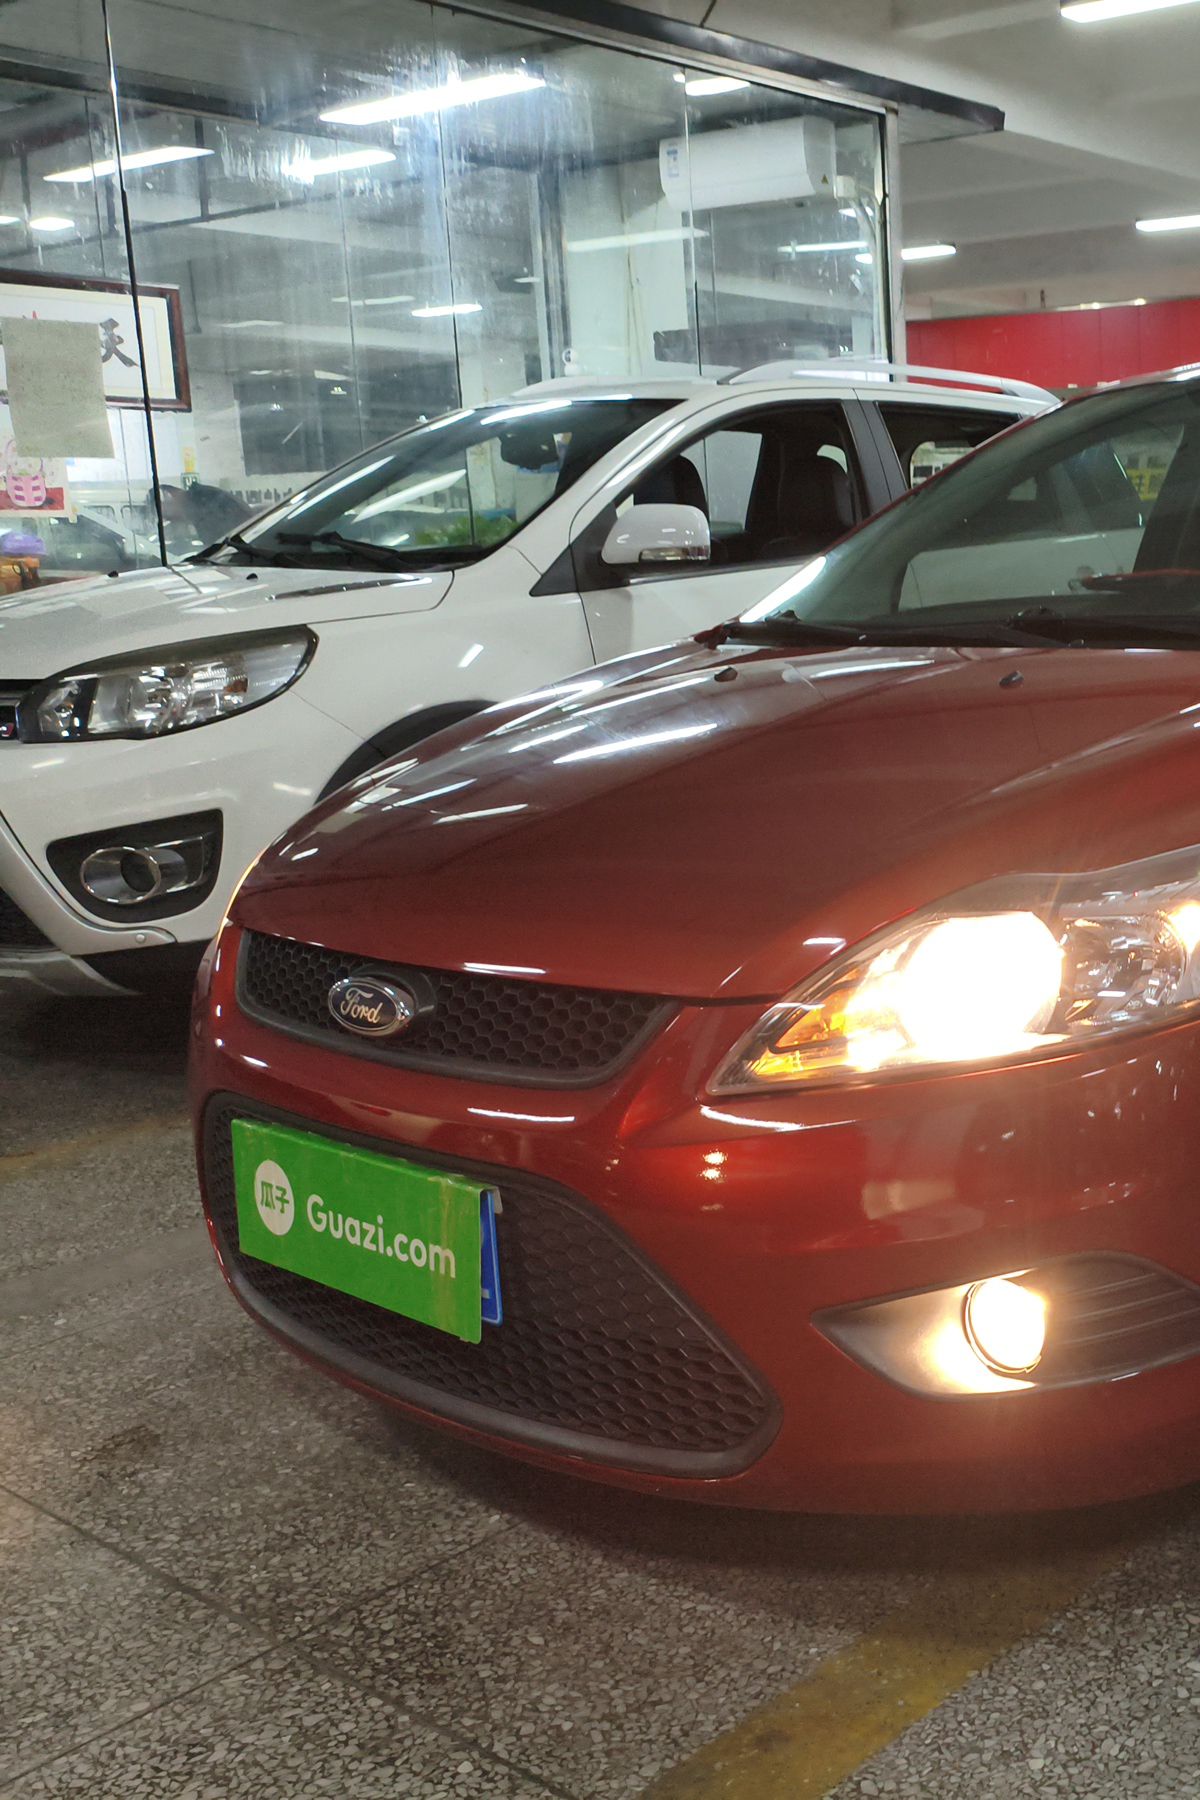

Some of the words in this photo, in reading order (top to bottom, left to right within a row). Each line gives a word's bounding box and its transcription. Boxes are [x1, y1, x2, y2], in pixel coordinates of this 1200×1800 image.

[340, 986, 384, 1024] Ford
[260, 1180, 290, 1214] 瓜子
[306, 1193, 457, 1279] Guazi.com
